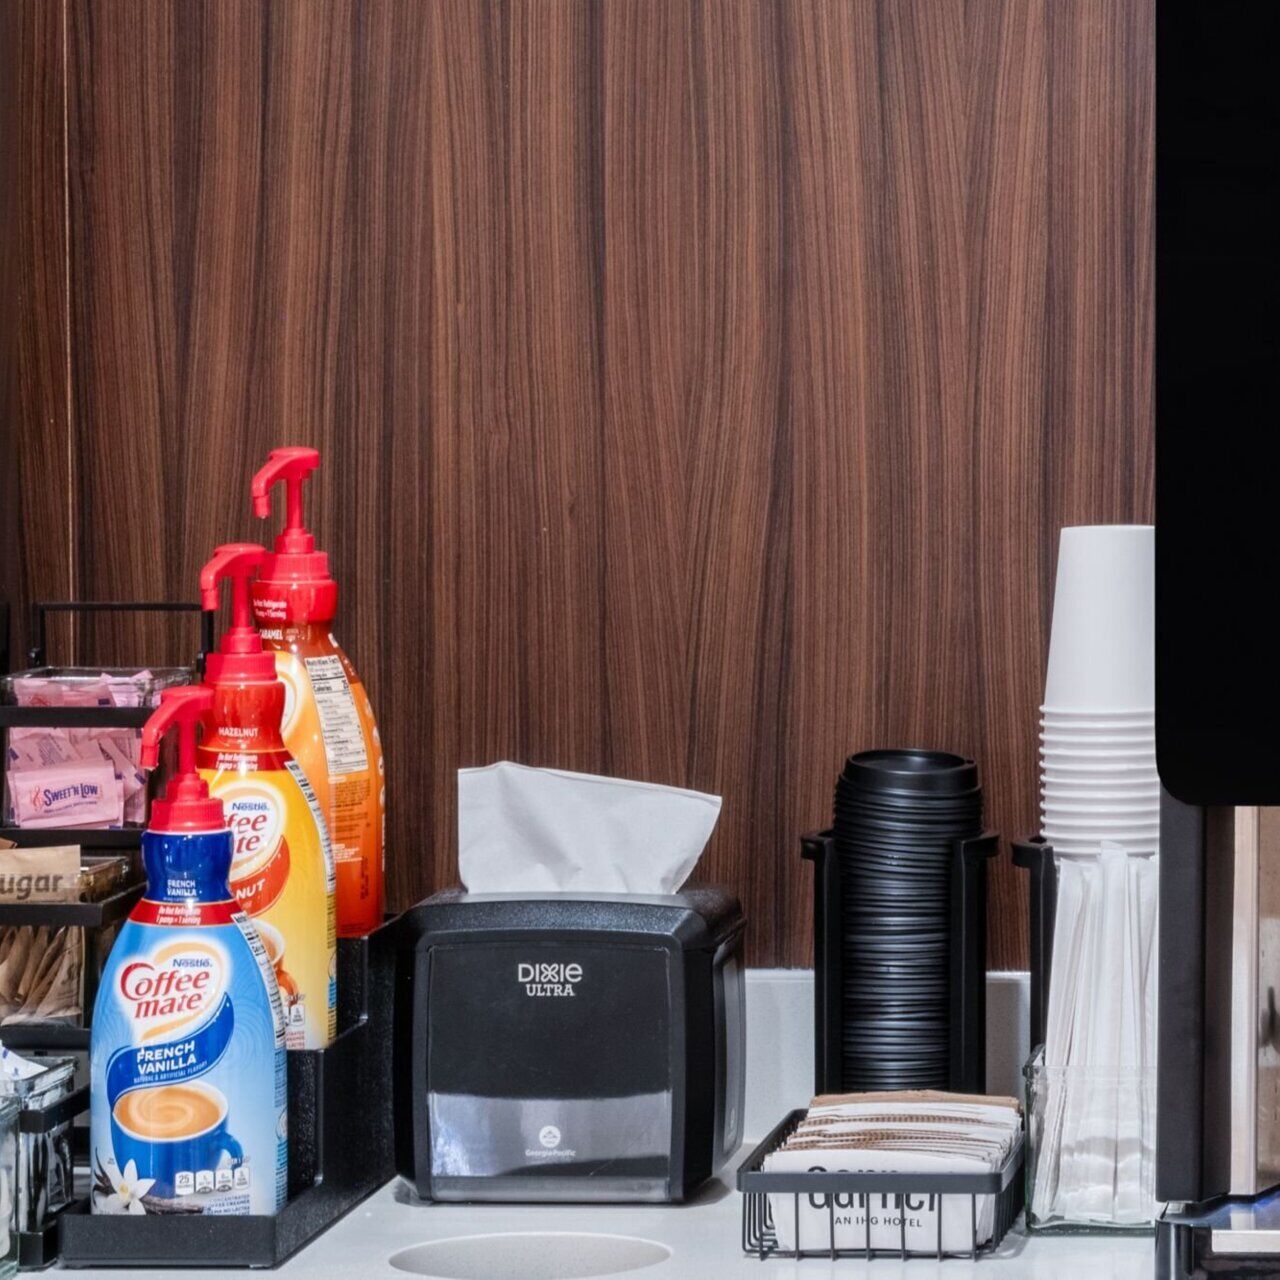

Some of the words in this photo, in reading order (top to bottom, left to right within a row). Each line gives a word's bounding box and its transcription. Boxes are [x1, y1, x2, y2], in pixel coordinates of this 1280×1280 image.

[218, 727, 259, 737] HAZELNUT
[120, 962, 210, 1001] Coffee
[525, 983, 576, 996] ULTRA
[134, 992, 202, 1019] mate
[136, 1039, 195, 1063] FRENCH
[137, 1053, 197, 1075] VANILLA
[834, 1216, 852, 1225] AN
